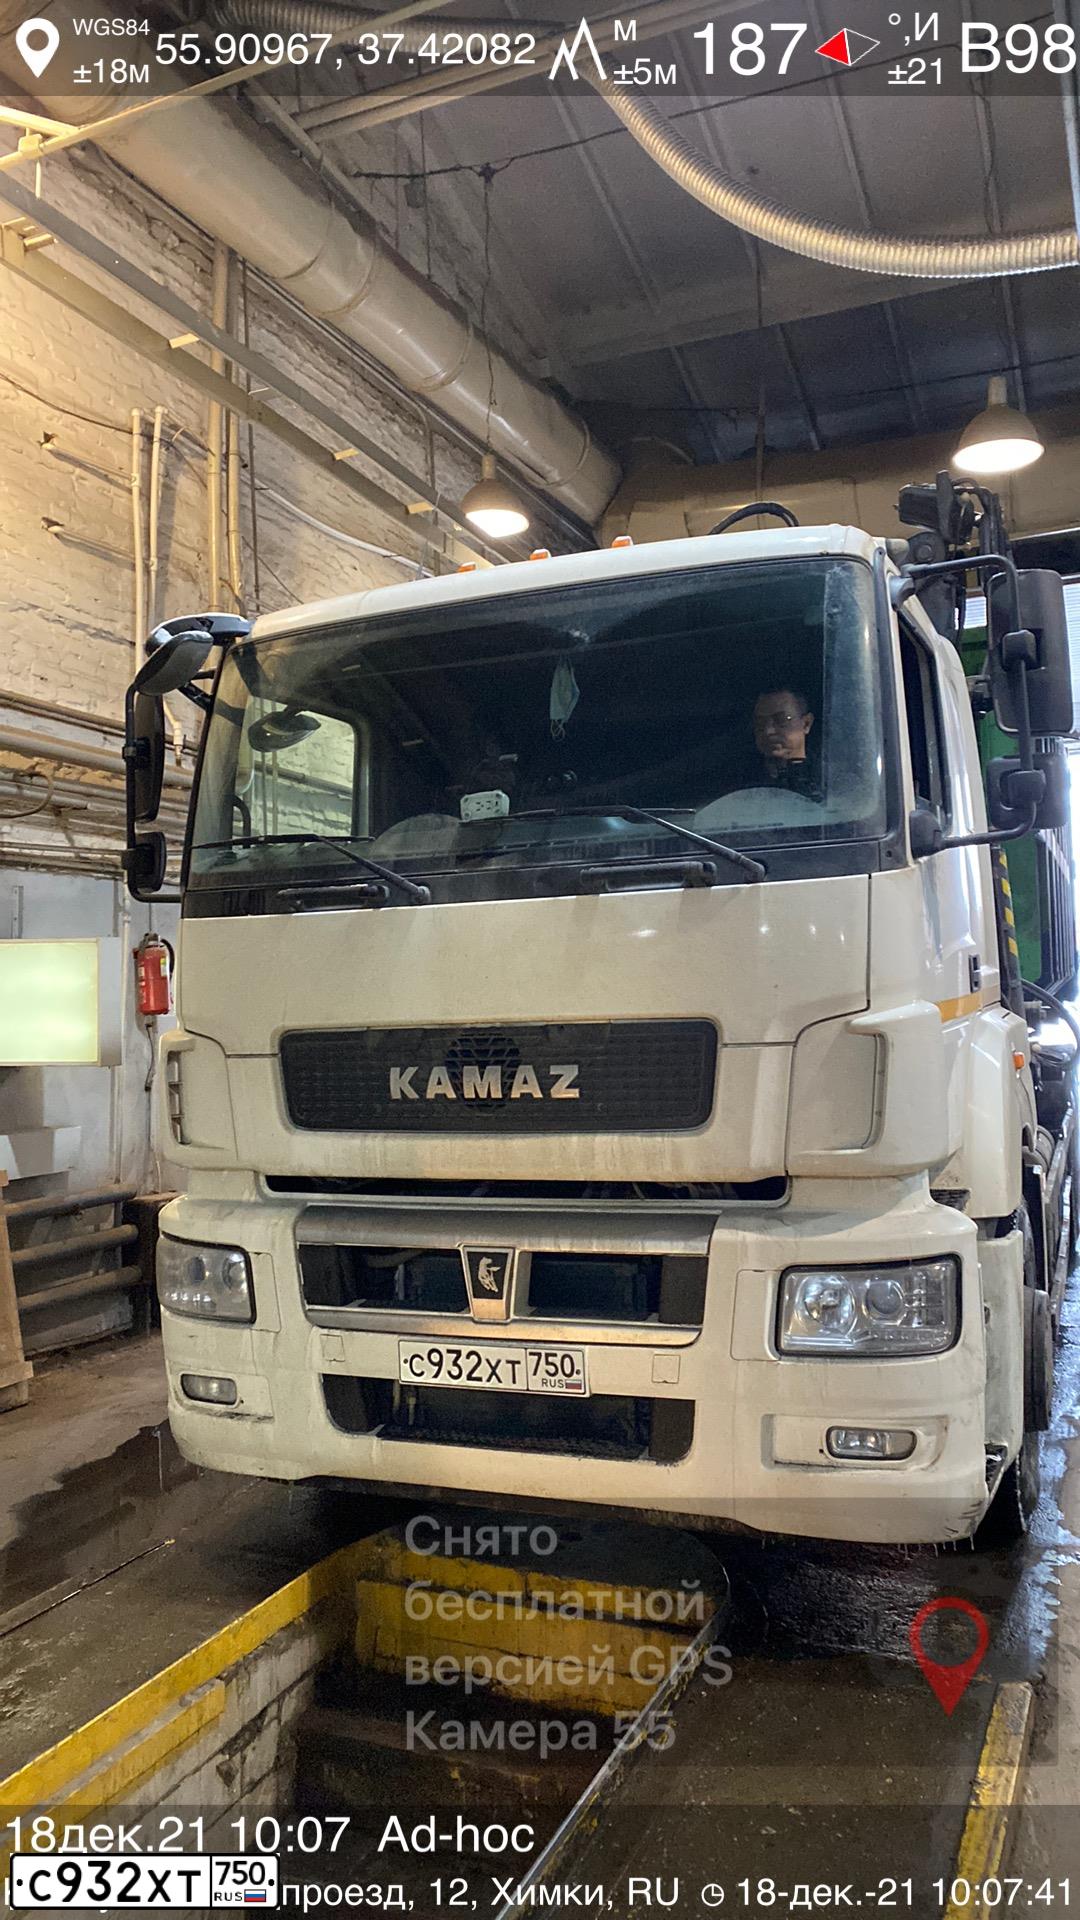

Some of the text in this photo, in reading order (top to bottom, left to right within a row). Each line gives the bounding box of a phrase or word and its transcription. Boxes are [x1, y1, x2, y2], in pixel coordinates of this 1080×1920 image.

[389, 1064, 580, 1100] KAMAZ
[528, 1351, 576, 1378] 750
[541, 1377, 565, 1389] RUS
